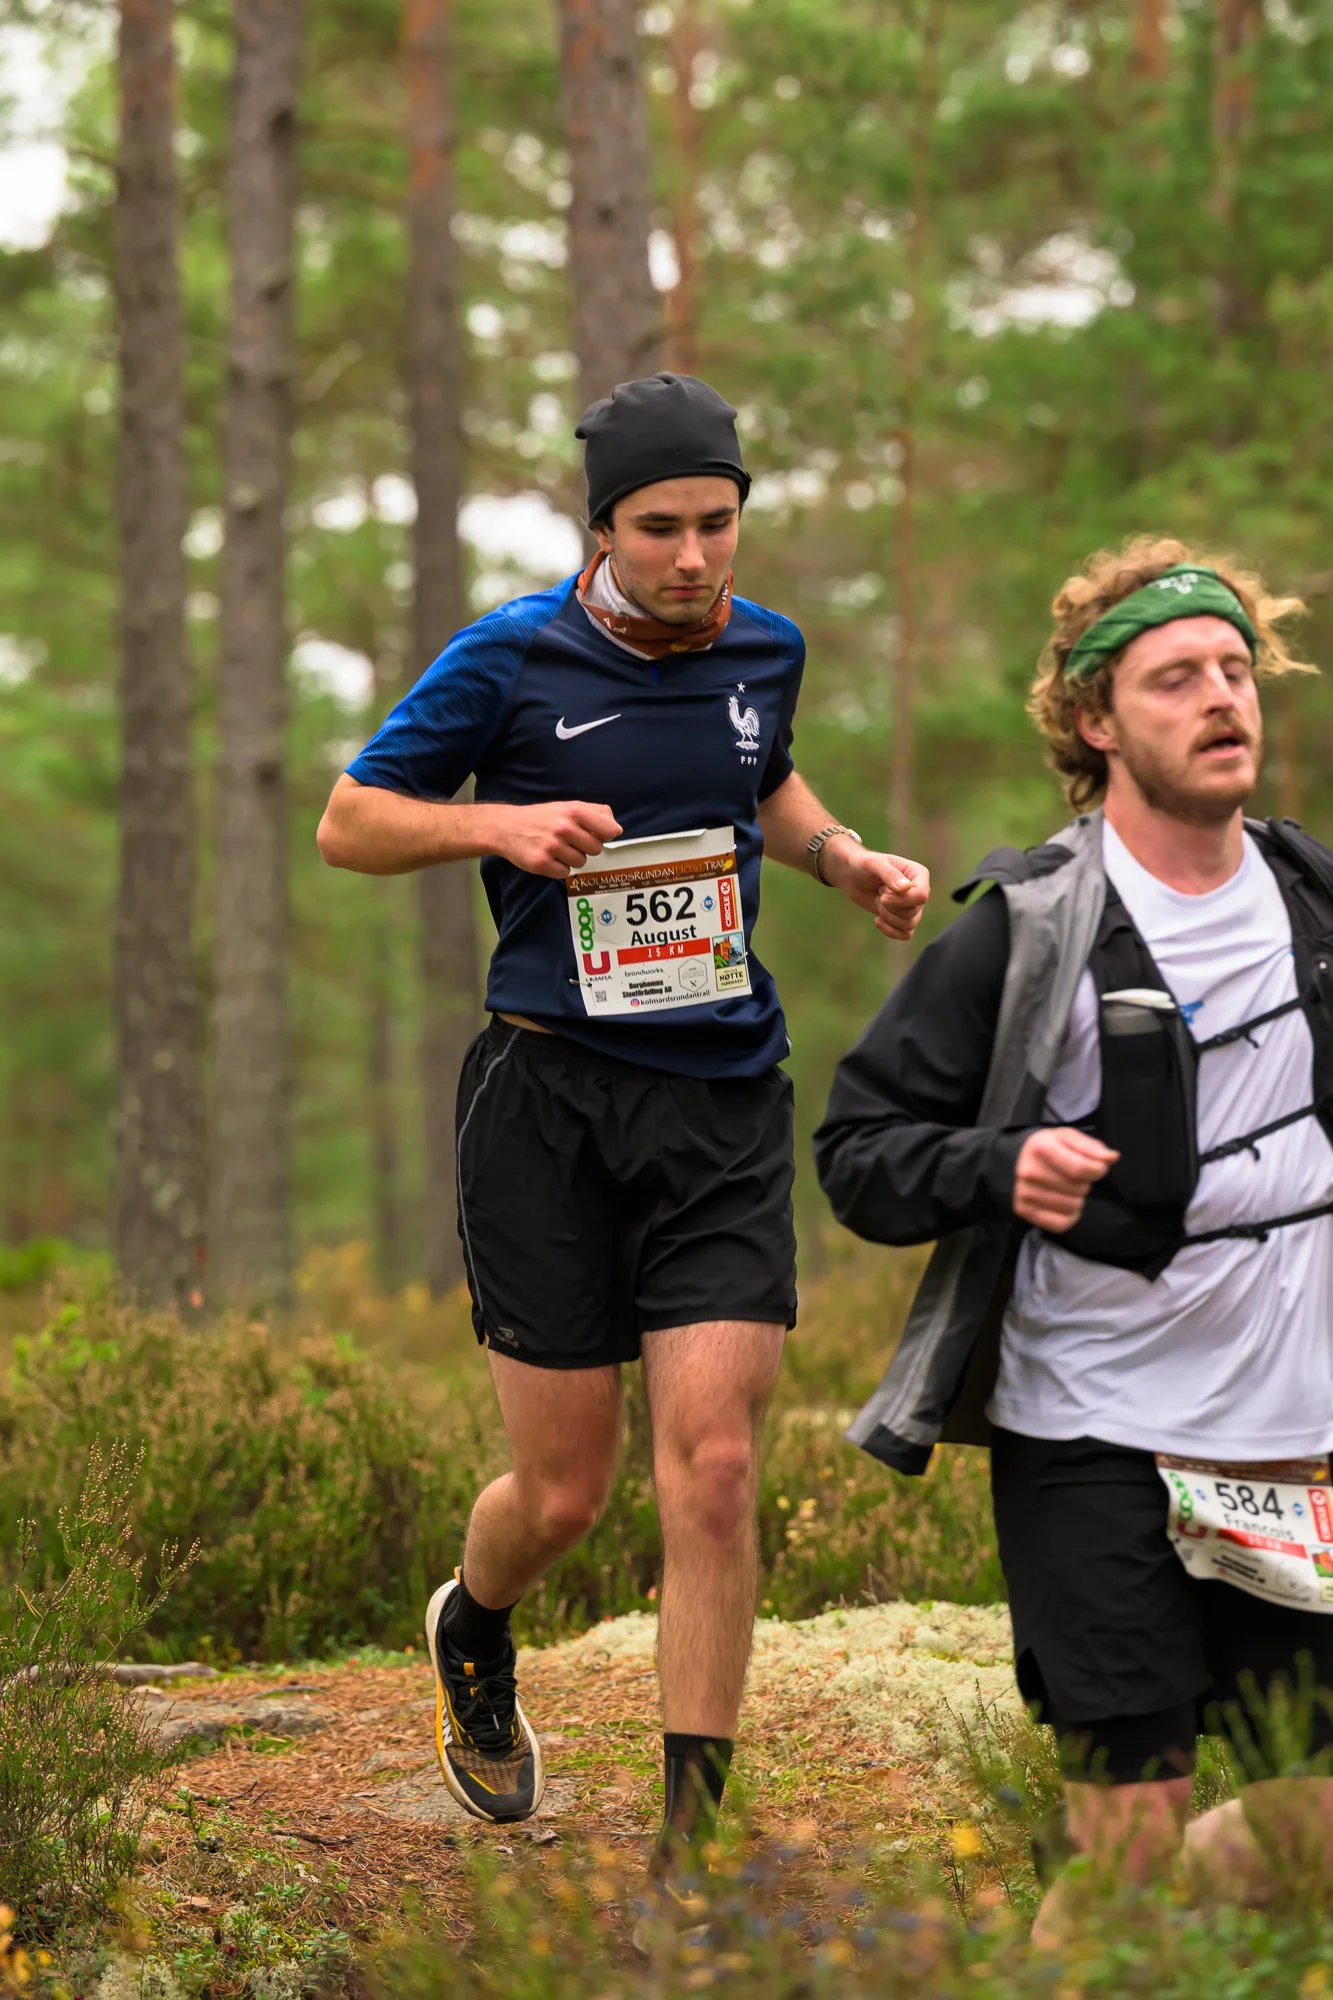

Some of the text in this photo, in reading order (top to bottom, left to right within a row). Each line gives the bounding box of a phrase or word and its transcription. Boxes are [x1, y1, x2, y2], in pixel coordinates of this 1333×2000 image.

[576, 897, 594, 952] coop
[625, 886, 696, 927] 562
[723, 895, 732, 928] CIRCLE
[630, 924, 697, 948] August
[647, 944, 684, 958] 15 KM
[1215, 1481, 1284, 1521] 584
